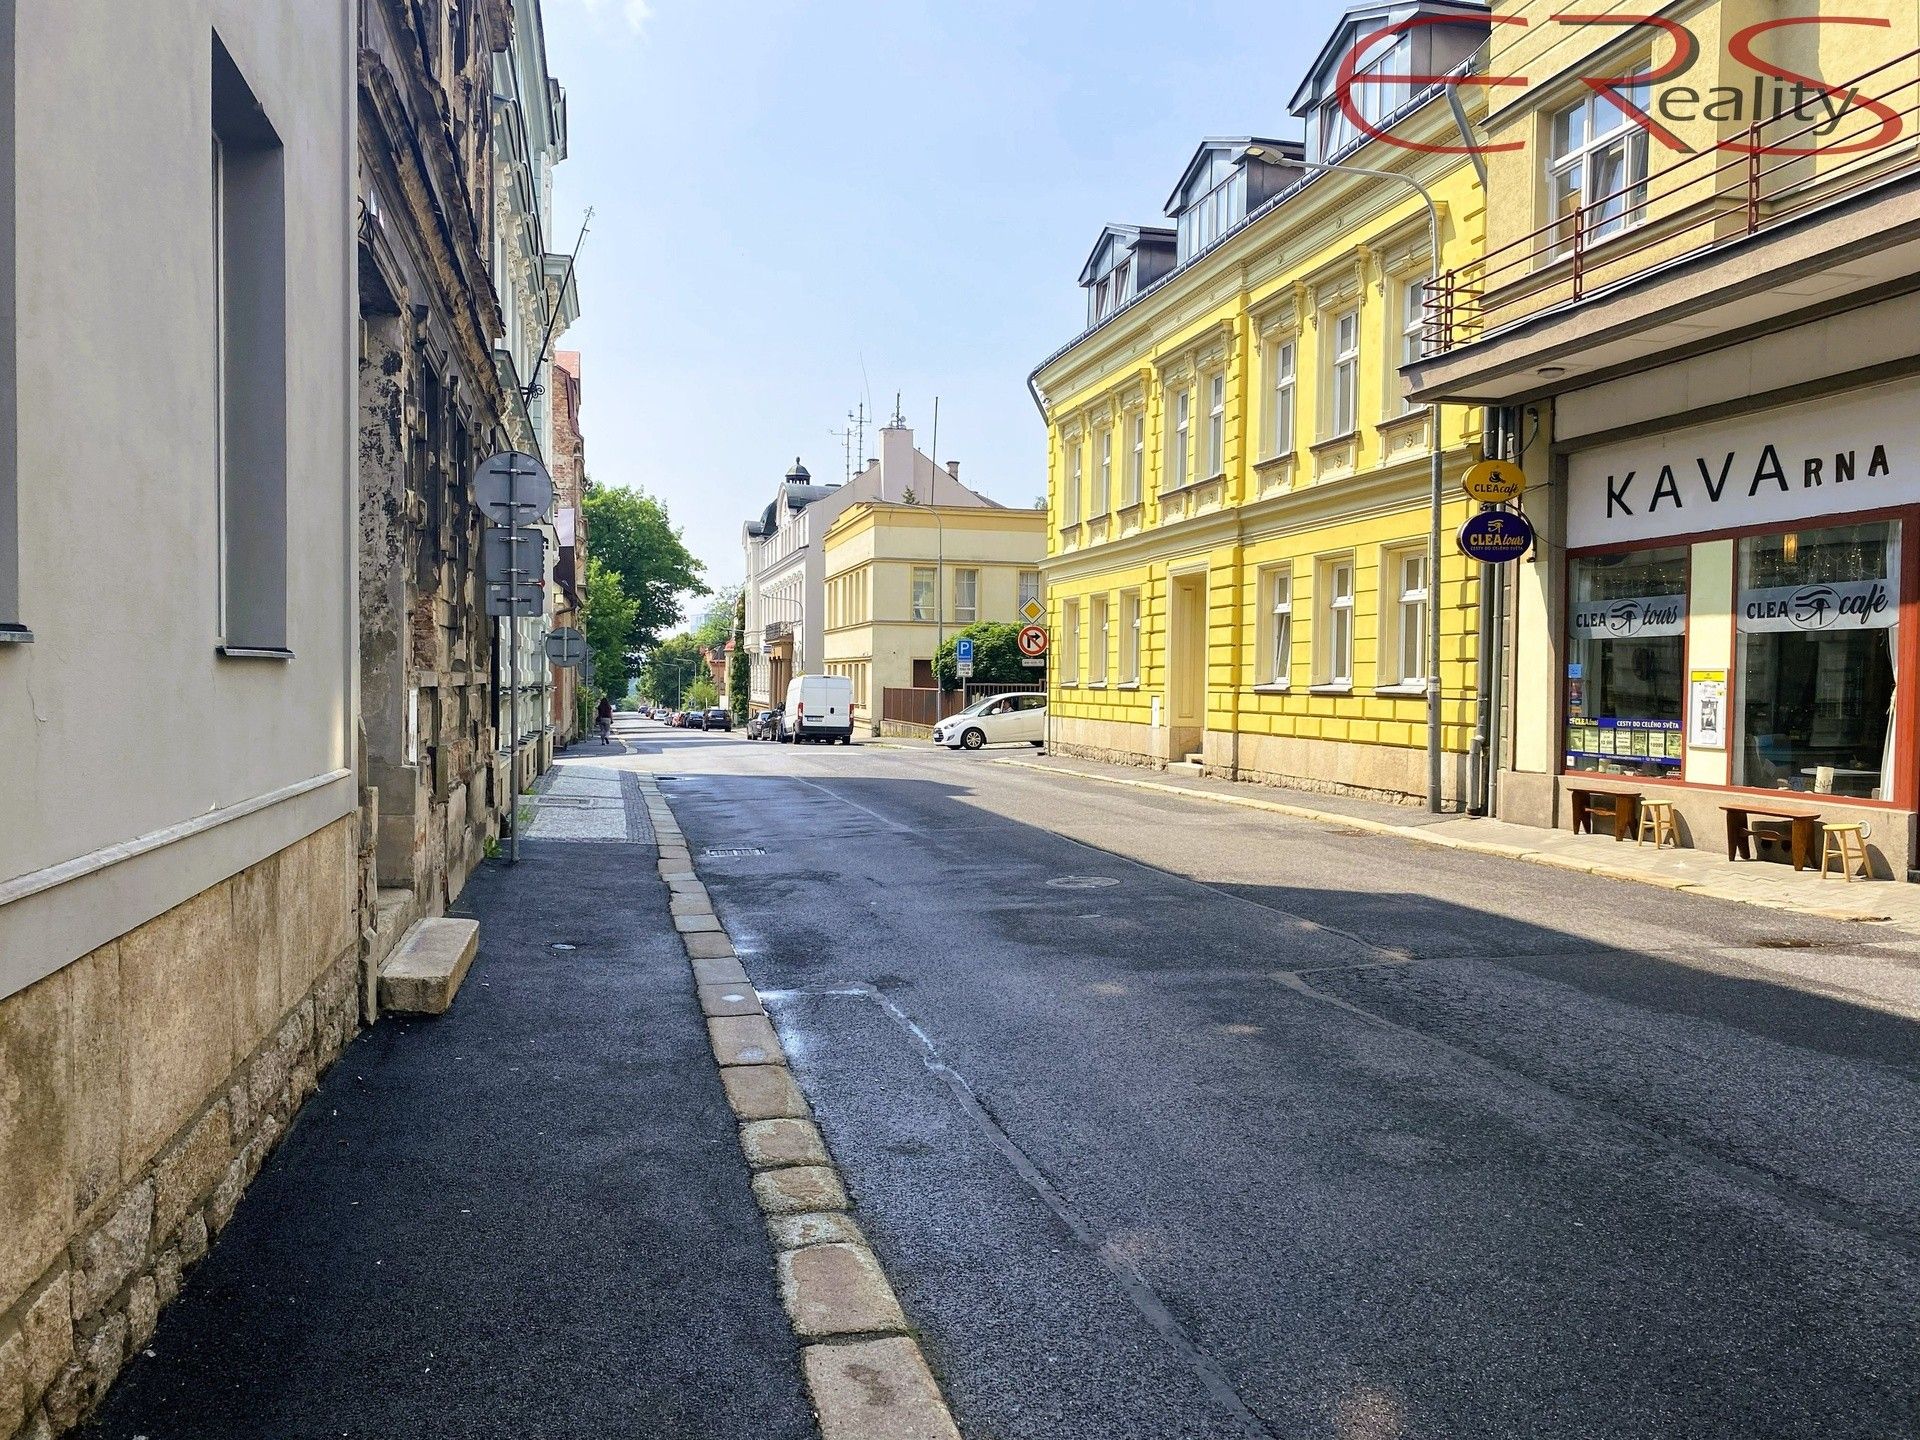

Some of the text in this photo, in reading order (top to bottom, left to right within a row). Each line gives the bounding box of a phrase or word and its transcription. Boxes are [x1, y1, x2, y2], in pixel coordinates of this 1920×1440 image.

[1576, 602, 1678, 628] CLEA tours
[1746, 583, 1889, 625] CLEA café
[1641, 720, 1661, 728] CELÉHO
[1663, 721, 1679, 729] SVĚTA
